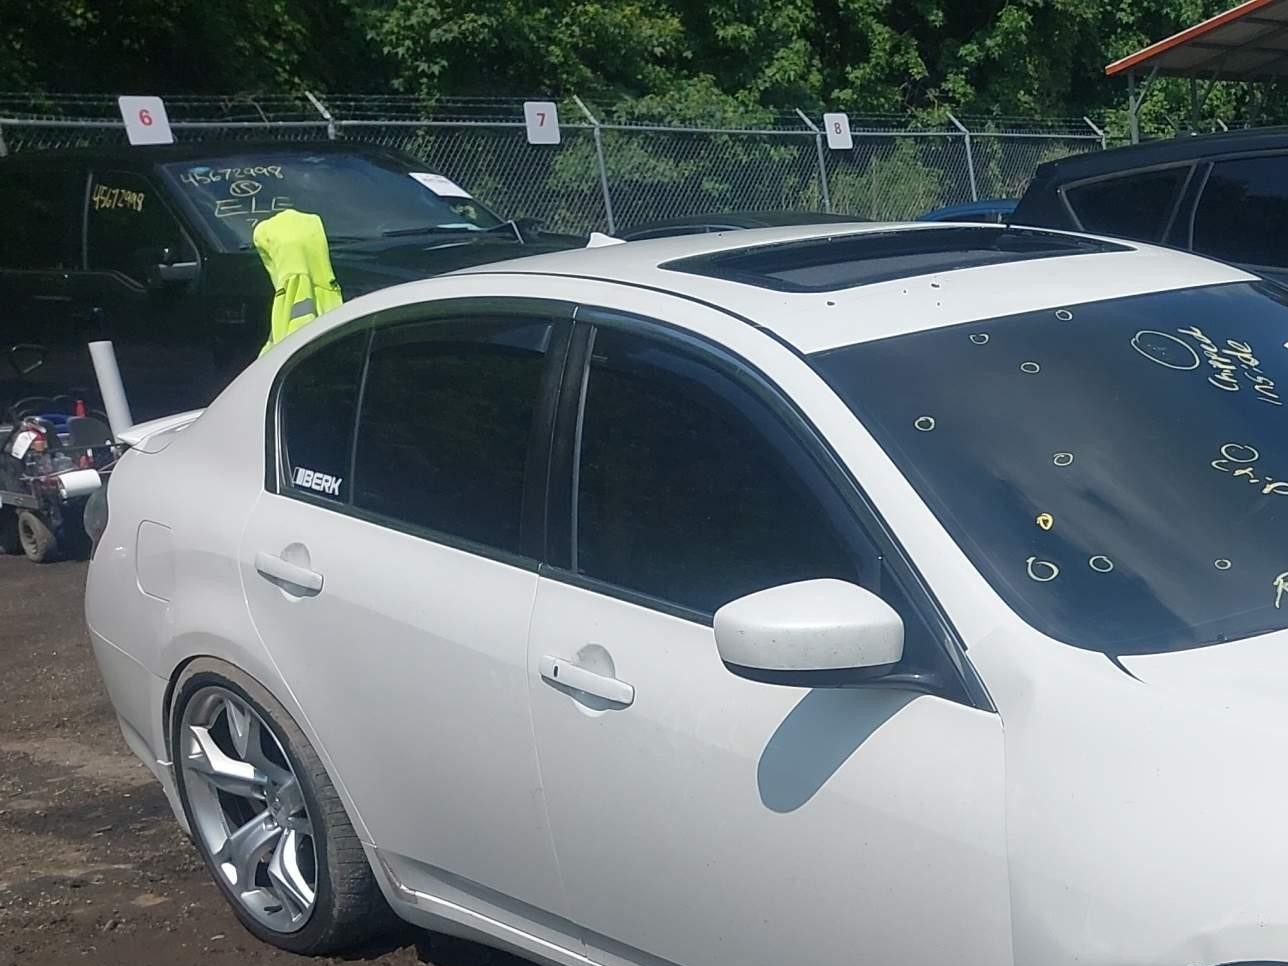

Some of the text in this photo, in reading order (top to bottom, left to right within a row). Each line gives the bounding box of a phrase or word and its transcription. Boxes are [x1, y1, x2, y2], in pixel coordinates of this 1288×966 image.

[139, 108, 152, 126] 6
[536, 112, 545, 127] 7
[834, 122, 842, 135] 8
[180, 165, 284, 186] 45672998
